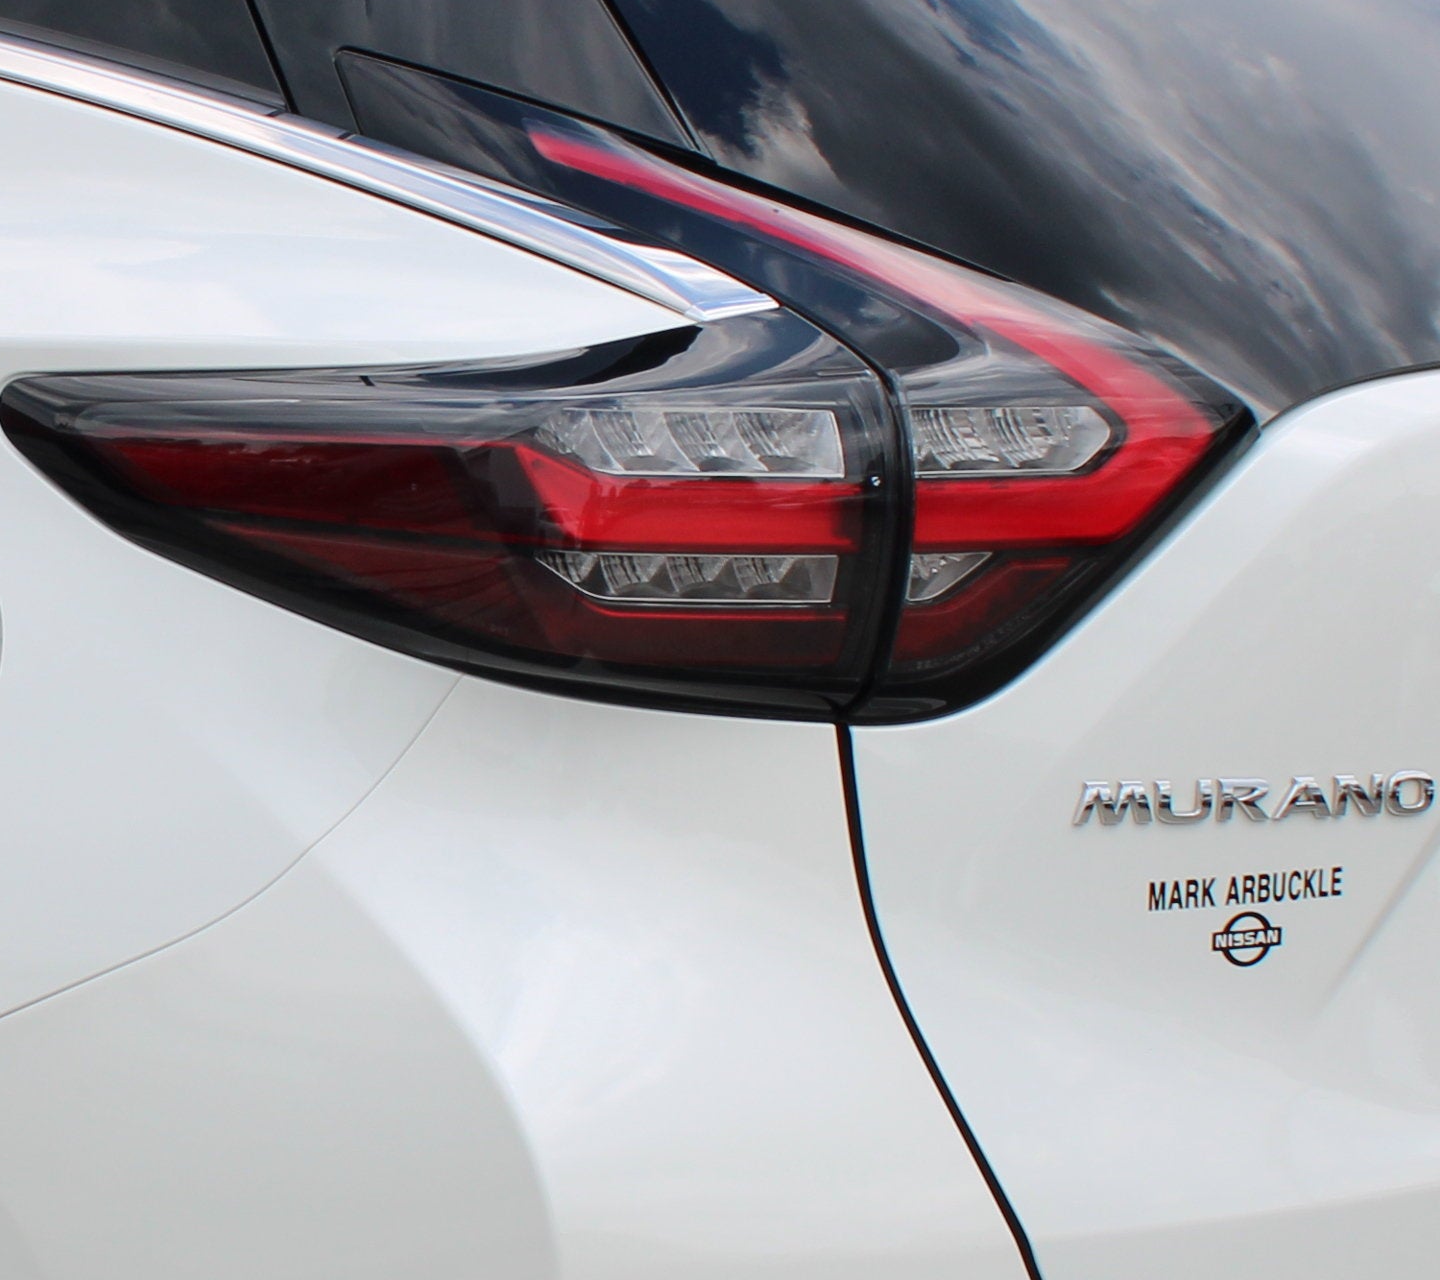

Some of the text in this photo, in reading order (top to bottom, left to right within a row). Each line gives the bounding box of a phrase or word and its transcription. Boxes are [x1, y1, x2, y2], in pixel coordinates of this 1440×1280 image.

[1071, 768, 1436, 827] MURANO
[1148, 866, 1343, 912] MARK ARBUCKLE
[1214, 928, 1280, 950] NISSAN
